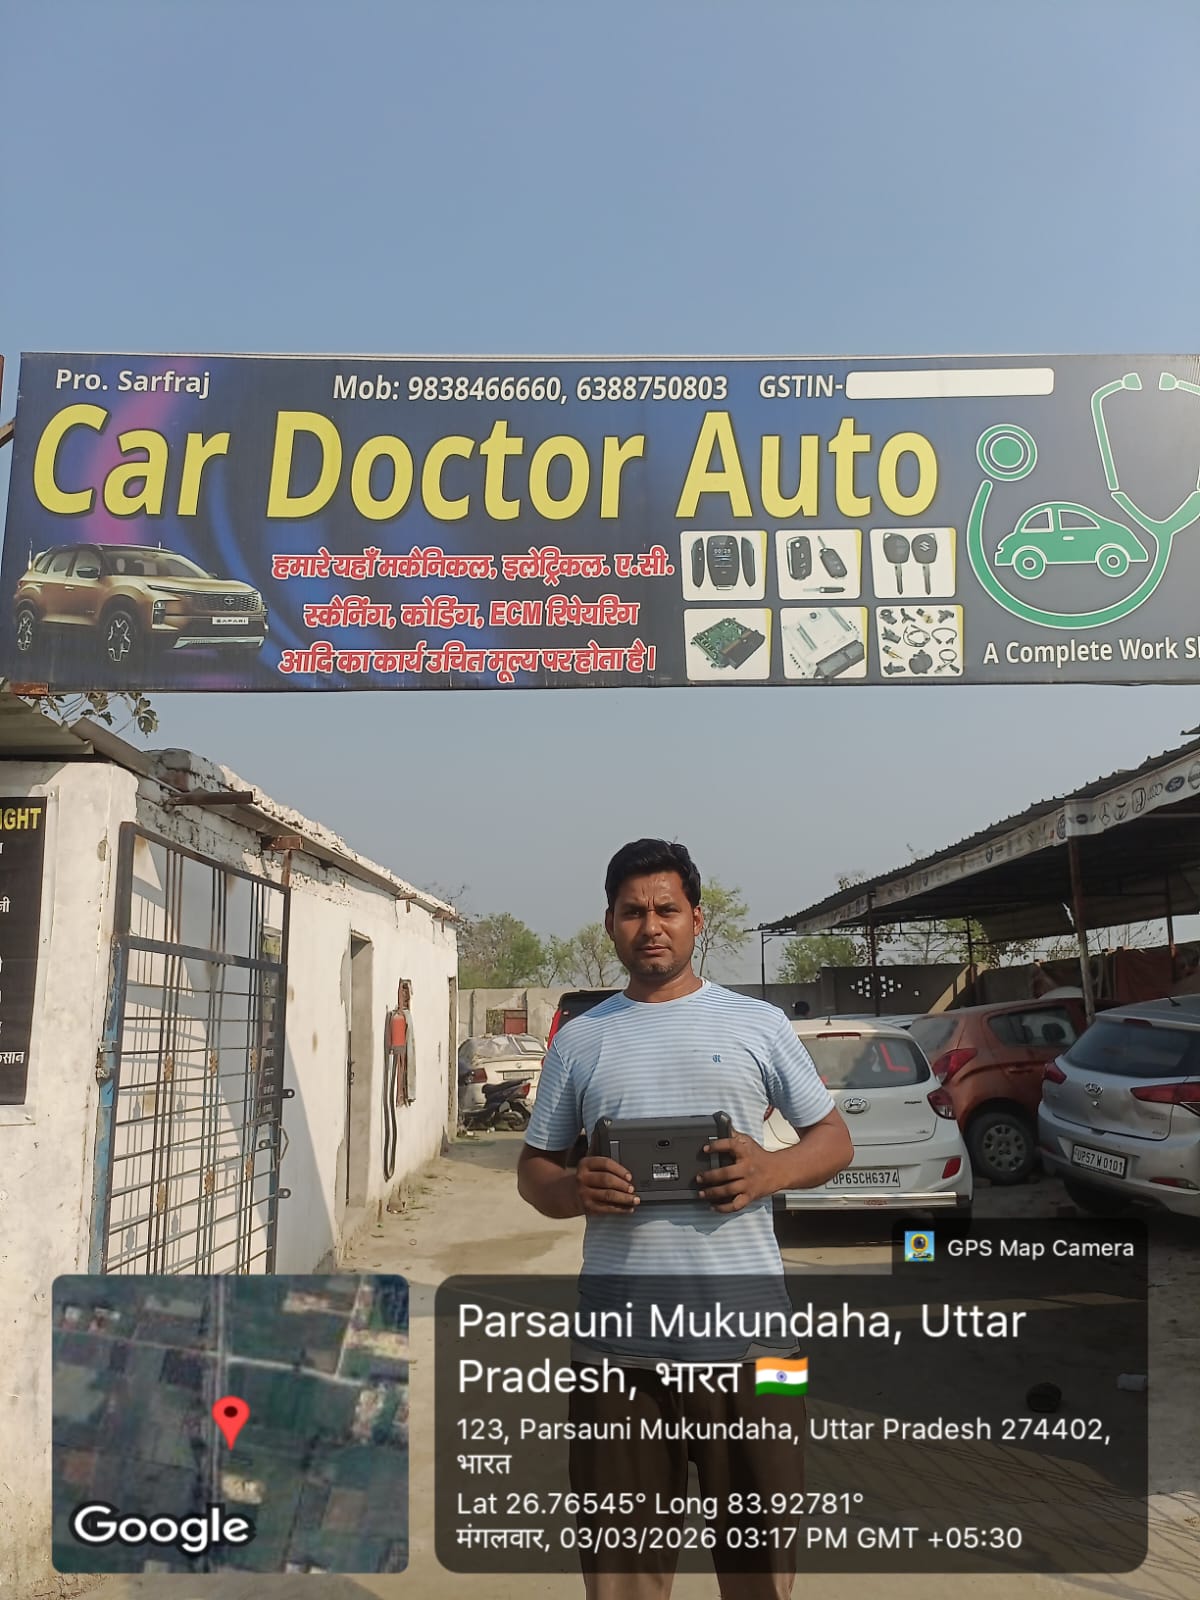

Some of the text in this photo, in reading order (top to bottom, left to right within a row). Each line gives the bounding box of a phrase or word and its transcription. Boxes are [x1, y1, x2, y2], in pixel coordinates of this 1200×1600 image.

[56, 369, 210, 399] Pro. Sarfraj
[333, 375, 728, 405] Mob: 9838466660, 6388750803
[759, 374, 843, 399] GSTIN-
[32, 403, 938, 521] Car Doctor Auto
[272, 547, 331, 579] हमारे
[333, 546, 381, 580] यहाँ
[378, 546, 497, 579] मकैनिकल,
[304, 595, 396, 629] स्कैनिंग,
[401, 595, 484, 629] कोडिंग,
[490, 600, 542, 625] ECM
[278, 640, 335, 674] आदि
[337, 650, 371, 673] का
[372, 640, 426, 673] कार्य
[425, 641, 487, 673] उचित
[487, 649, 540, 683] मूल्य
[542, 648, 574, 672] पर
[574, 640, 625, 673] होता
[983, 635, 1200, 668] A Complete Work S
